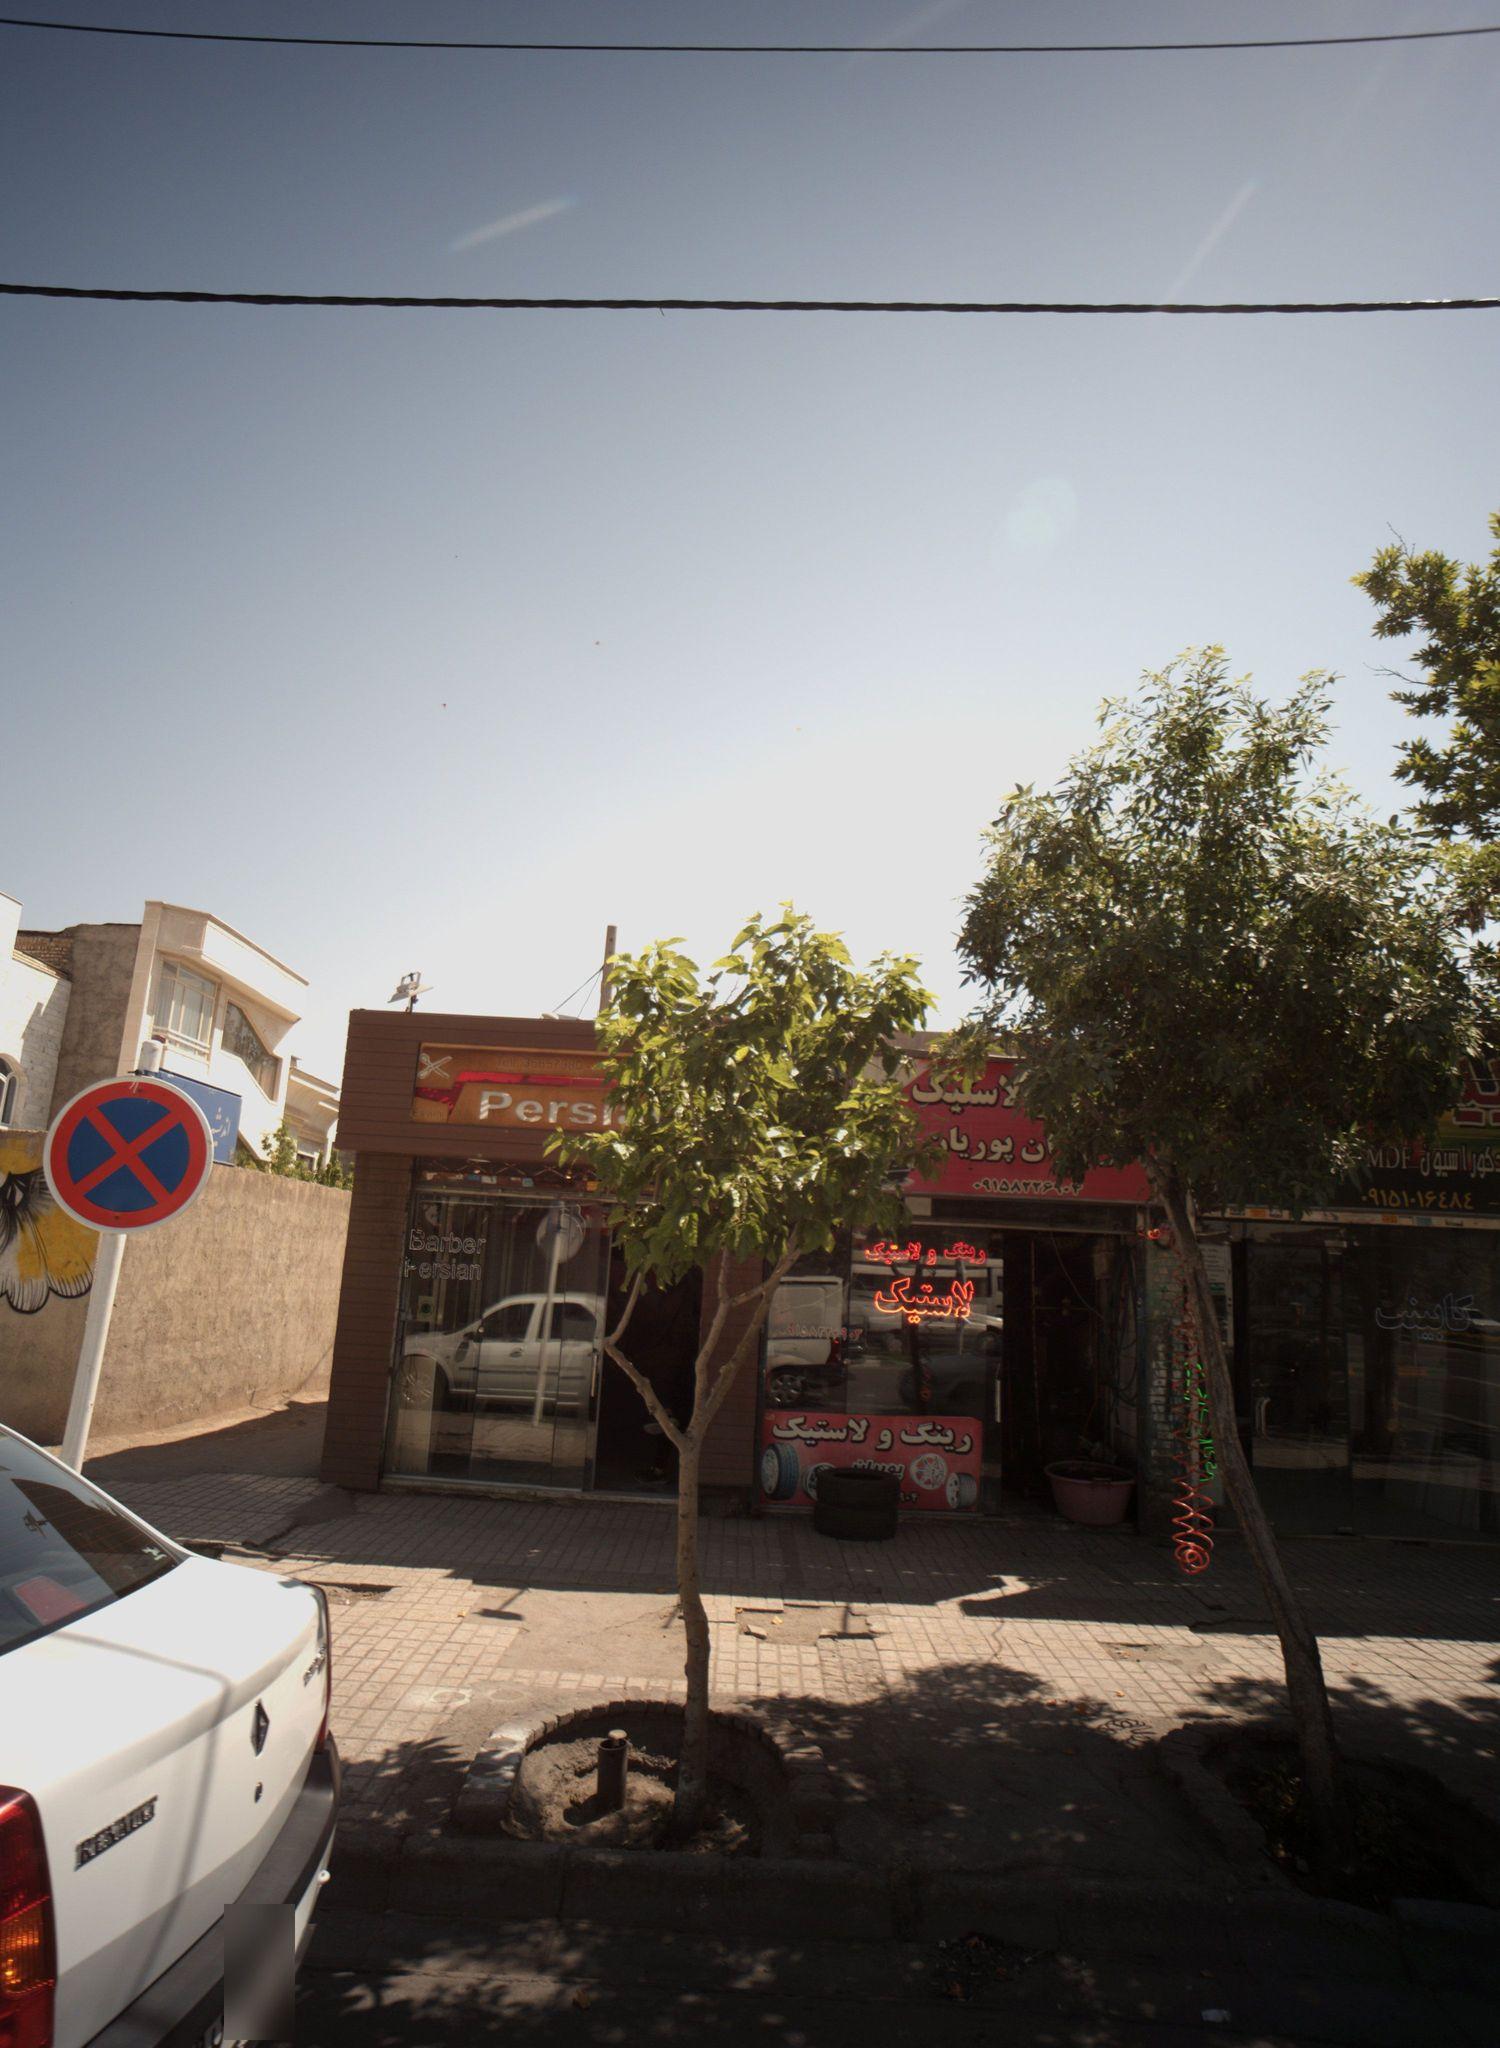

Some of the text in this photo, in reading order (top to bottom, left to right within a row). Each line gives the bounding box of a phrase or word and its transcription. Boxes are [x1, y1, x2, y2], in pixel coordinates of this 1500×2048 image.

[409, 1228, 487, 1255] Barber
[865, 1241, 987, 1265] رینگ و لاستیک
[404, 1257, 482, 1281] Persian
[874, 1278, 974, 1323] لاستیک
[1376, 1293, 1473, 1341] کابینت
[773, 1416, 973, 1454] رینگ و لاستیک
